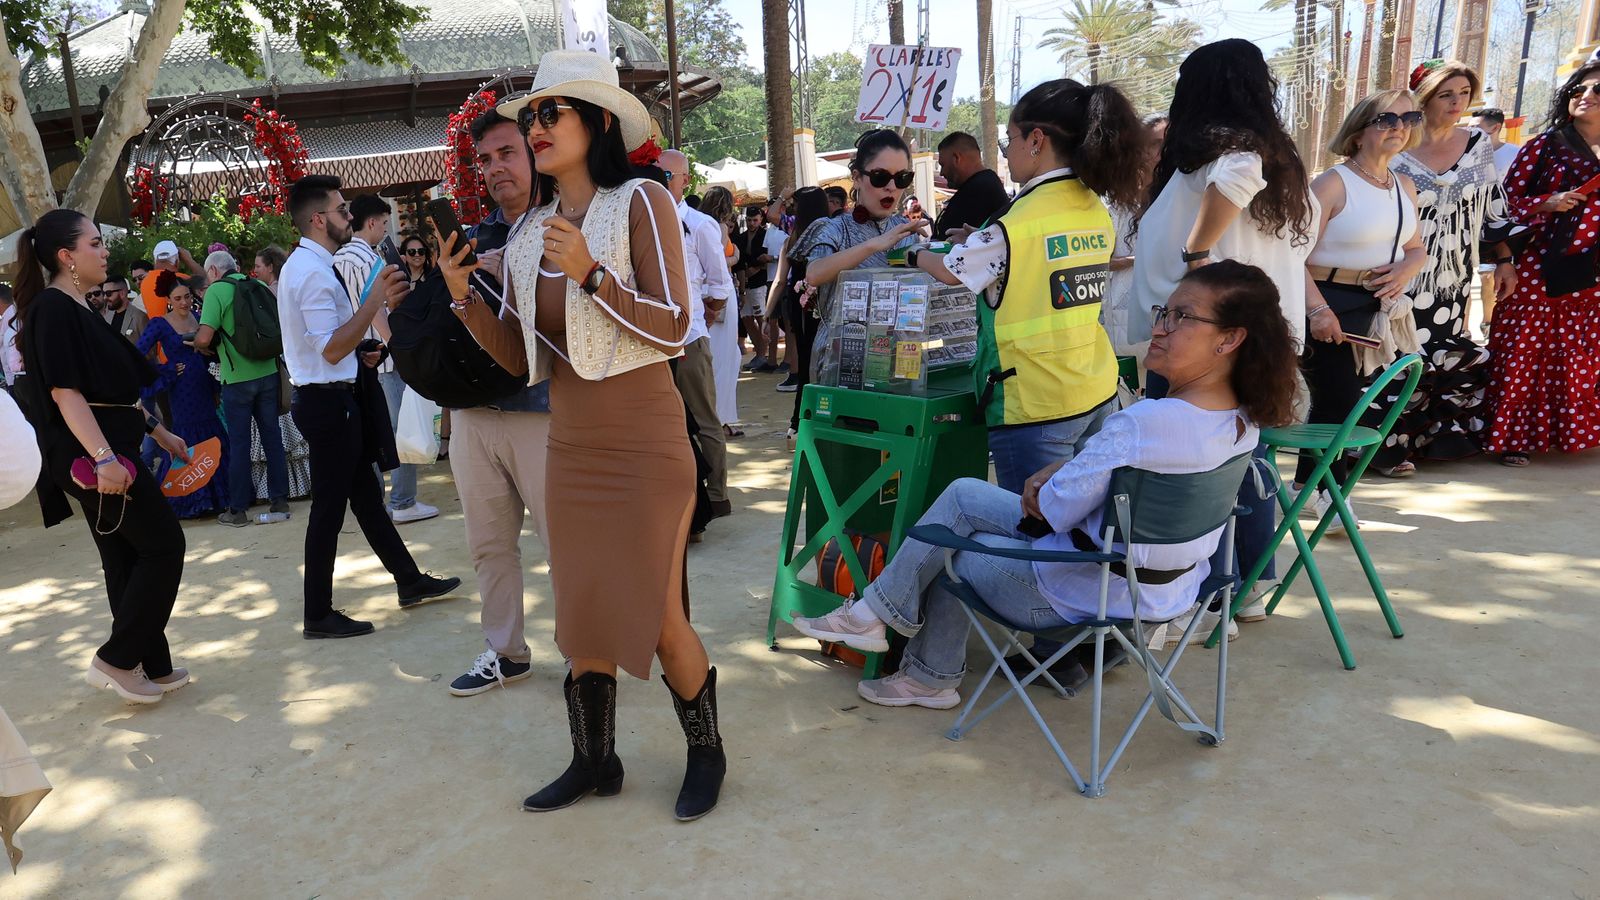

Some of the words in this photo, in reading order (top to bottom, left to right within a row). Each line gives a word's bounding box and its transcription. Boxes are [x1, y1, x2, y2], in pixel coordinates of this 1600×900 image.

[1071, 234, 1107, 251] ONCE
[1074, 272, 1096, 283] grupo
[1076, 281, 1105, 300] ONC
[178, 456, 214, 491] SUITEX
